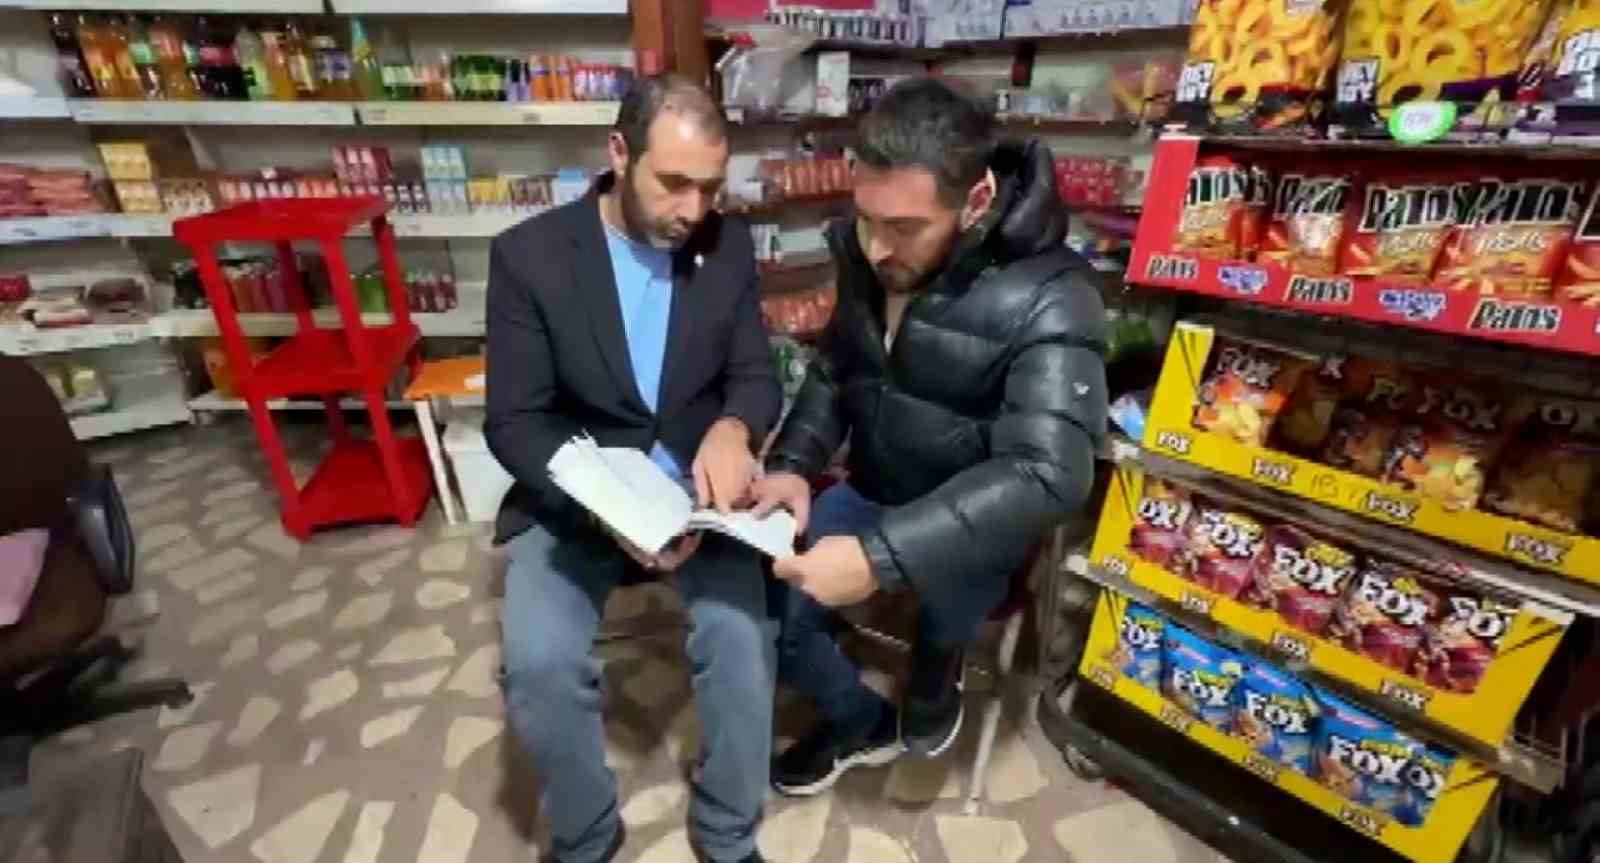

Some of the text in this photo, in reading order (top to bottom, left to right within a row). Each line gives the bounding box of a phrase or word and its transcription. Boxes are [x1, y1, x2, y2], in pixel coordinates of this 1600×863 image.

[1274, 543, 1351, 595] FOX
[1361, 573, 1429, 626] FOX
[1173, 667, 1232, 708] FOX
[1246, 690, 1309, 734] FOX
[1330, 735, 1407, 785] FOX
